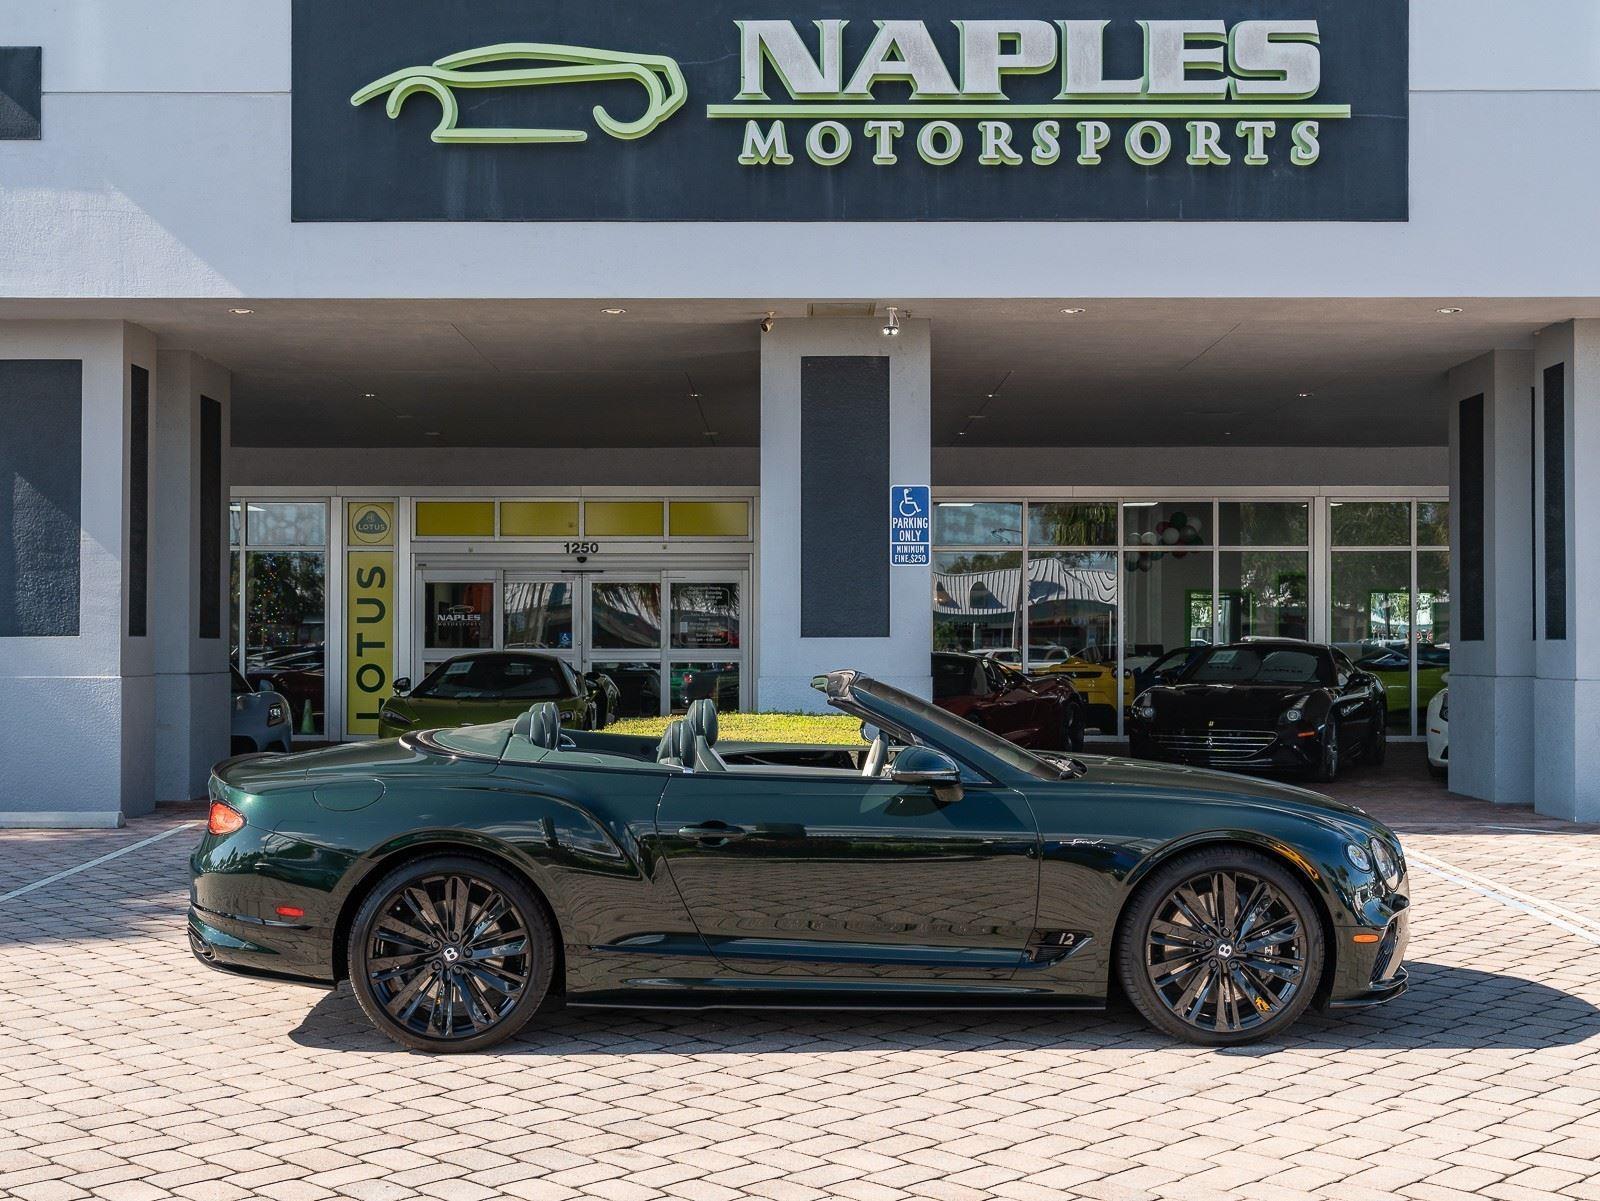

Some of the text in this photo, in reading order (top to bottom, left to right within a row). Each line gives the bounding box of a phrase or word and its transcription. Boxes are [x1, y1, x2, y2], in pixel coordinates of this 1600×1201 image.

[733, 19, 1322, 101] NAPLES
[737, 119, 1321, 167] MOTORSPORTS
[358, 523, 386, 531] LOTUS
[892, 517, 928, 528] PARKING
[899, 530, 921, 541] ONLY
[564, 542, 599, 554] 1250
[896, 545, 924, 553] MINIMUM
[894, 553, 927, 563] FINE $250
[356, 565, 386, 720] LOTUS
[1058, 932, 1075, 945] 12
[443, 947, 458, 961] B
[1218, 944, 1232, 957] B
